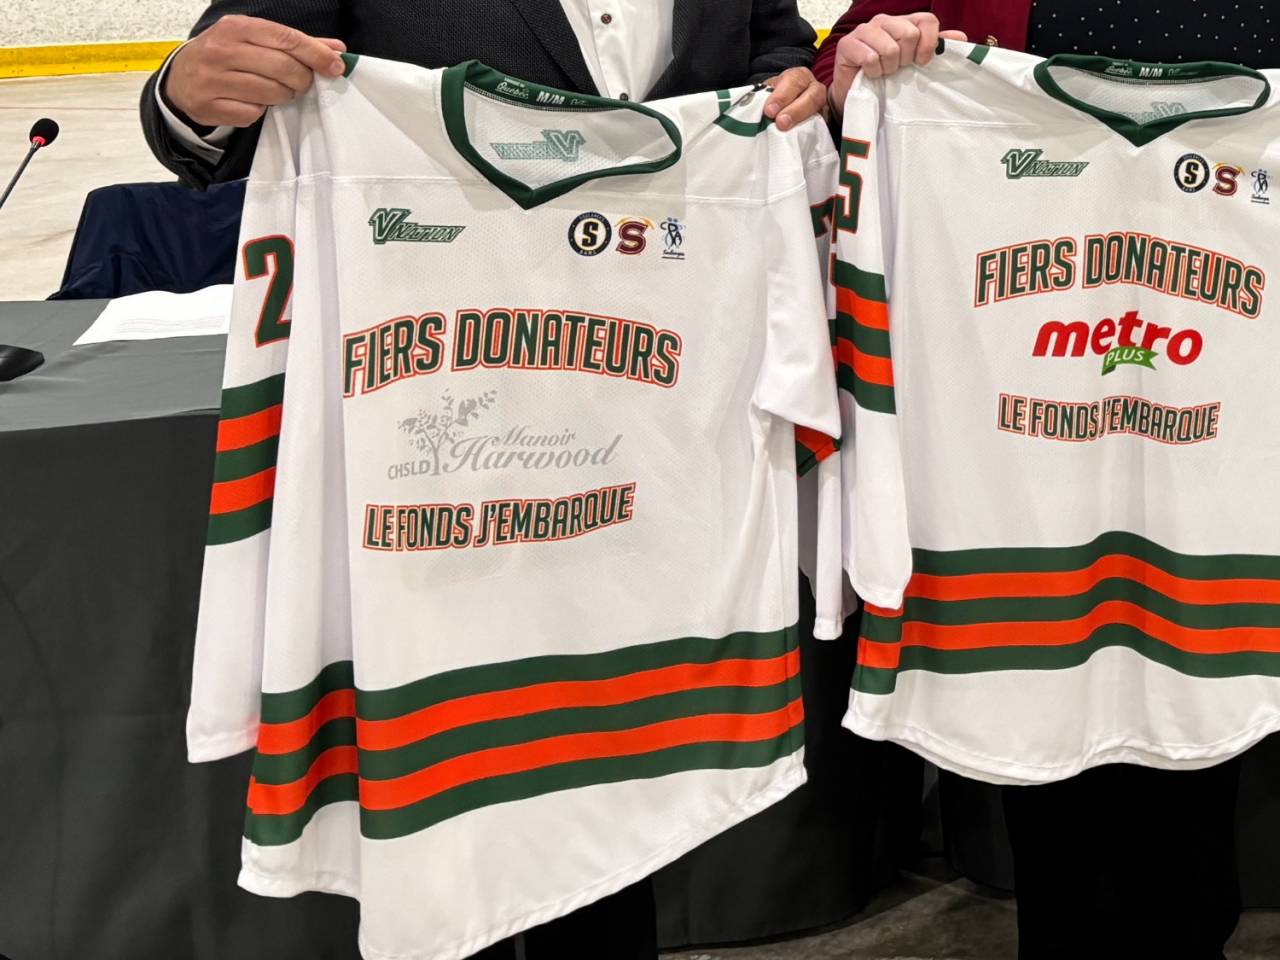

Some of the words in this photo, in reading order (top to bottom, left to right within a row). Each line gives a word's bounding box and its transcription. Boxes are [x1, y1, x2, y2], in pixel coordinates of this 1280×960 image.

[1139, 67, 1163, 78] M/M
[536, 90, 566, 105] M/M
[834, 136, 871, 234] 5
[1184, 161, 1199, 185] S
[1213, 166, 1241, 196] S
[582, 221, 599, 247] S
[616, 221, 648, 255] S
[242, 234, 295, 348] 2
[974, 237, 1077, 308] FIERS
[1082, 231, 1265, 319] DONATEURS
[342, 311, 447, 398] FIERS
[450, 308, 682, 389] DONATEURS
[1031, 310, 1203, 366] metro
[1105, 349, 1145, 367] PLUS
[490, 424, 576, 448] Manoir
[998, 393, 1027, 435] LE
[1028, 398, 1100, 442] FONDS
[1099, 395, 1221, 445] J'EMBARQUE
[387, 460, 431, 480] CHSLD
[442, 434, 624, 474] Harwood
[362, 504, 395, 551] LE
[395, 503, 474, 552] FONDS
[473, 482, 636, 548] J'EMBARQUE
